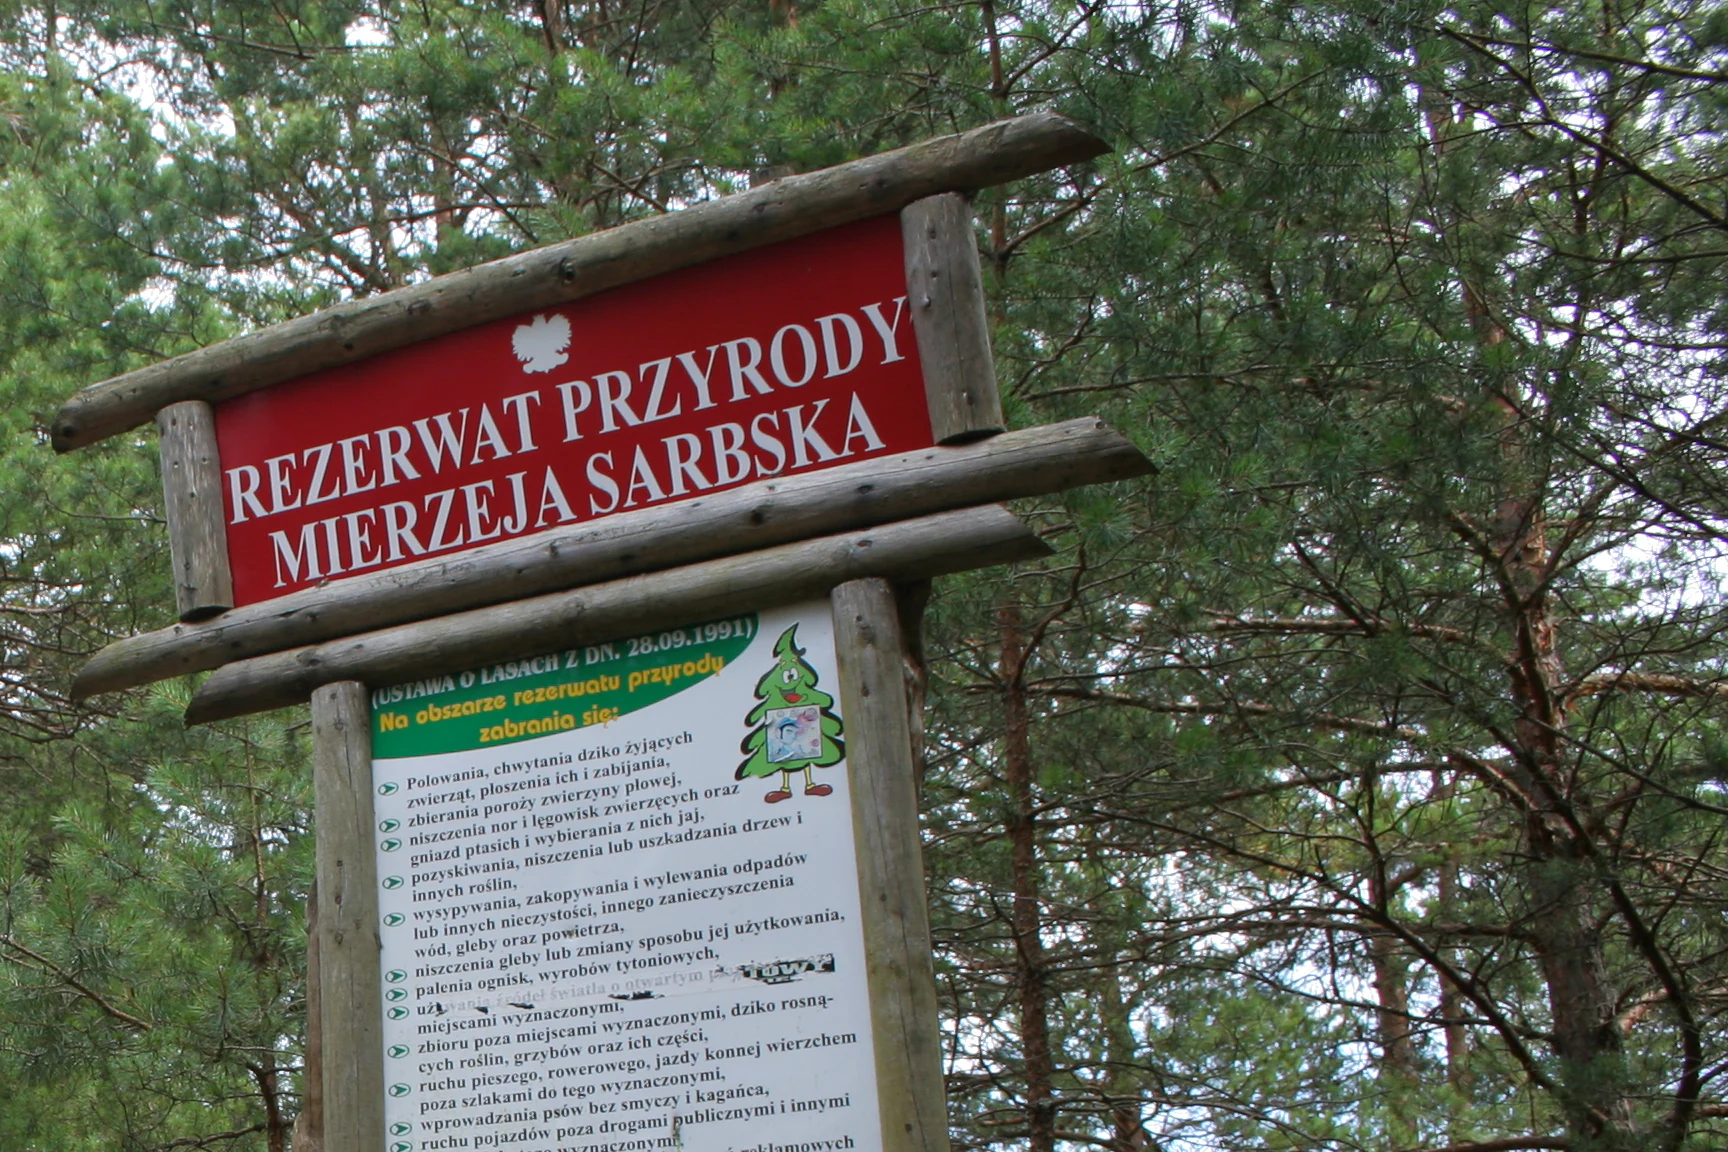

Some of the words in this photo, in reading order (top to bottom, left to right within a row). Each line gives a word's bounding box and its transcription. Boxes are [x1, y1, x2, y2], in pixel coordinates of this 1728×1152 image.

[225, 390, 542, 525] REZERWAT
[555, 295, 907, 442] PRZYRODY
[268, 465, 577, 589] MIERZEJA
[586, 391, 886, 515] SARBSKA
[372, 675, 455, 709] (USTAWA
[460, 671, 475, 688] O
[480, 655, 559, 685] LASACH
[565, 650, 579, 669] Z
[585, 642, 620, 665] DN.
[627, 618, 753, 658] 28.09.1991)
[380, 712, 409, 732] Na
[415, 694, 506, 725] obszarze
[513, 674, 620, 707] rezerwatu
[628, 652, 725, 692] przyrody
[479, 710, 575, 742] zabrania
[583, 703, 619, 728] się:
[406, 765, 490, 791] Polowania,
[492, 751, 573, 776] chwytania
[576, 744, 621, 762] dziko
[624, 729, 693, 755] żyjących
[406, 787, 476, 810] zwierząt,
[554, 768, 579, 785] ich
[583, 766, 589, 781] i
[592, 755, 671, 779] zabijania,
[407, 804, 480, 828] zbierania
[483, 795, 536, 820] poroży
[540, 785, 619, 807] zwierzyny
[408, 822, 487, 847] niszczenia
[490, 819, 518, 834] nor
[521, 814, 528, 829] i
[531, 804, 600, 830] lęgowisk
[603, 787, 699, 817] zwierzęcych
[703, 783, 740, 800] oraz
[409, 844, 461, 869] gniazd
[464, 835, 521, 861] ptasich
[524, 833, 530, 848] i
[533, 820, 622, 846] wybierania
[626, 820, 636, 832] z
[638, 811, 673, 830] nich
[677, 806, 705, 827] jaj,
[410, 856, 520, 888] pozyskiwania,
[523, 843, 604, 868] niszczenia
[607, 837, 634, 855] lub
[637, 821, 738, 850] uszkadzania
[741, 815, 791, 833] drzew
[796, 809, 803, 825] i
[411, 882, 464, 903] innych
[468, 876, 518, 895] roślin,
[412, 894, 522, 921] wysypywania,
[525, 878, 629, 906] zakopywania
[633, 875, 639, 890] i
[642, 863, 729, 888] wylewania
[731, 851, 808, 876] odpadów
[413, 924, 439, 941] lub
[442, 916, 496, 937] innych
[500, 902, 598, 929] nieczystości,
[600, 896, 655, 915] innego
[658, 873, 795, 906] zanieczyszczenia
[413, 941, 452, 959] wód,
[455, 937, 496, 958] gleby
[501, 933, 538, 948] oraz
[540, 921, 625, 947] powietrza,
[414, 956, 495, 978] niszczenia
[498, 950, 541, 972] gleby
[544, 945, 572, 962] lub
[575, 939, 634, 958] zmiany
[637, 927, 704, 952] sposobu
[708, 921, 730, 943] jej
[733, 907, 846, 936] użytkowania,
[415, 978, 473, 1001] palenia
[476, 970, 534, 992] ognisk,
[537, 960, 610, 982] wyrobów
[615, 944, 720, 972] tytoniowych,
[416, 1012, 497, 1036] miejscami
[417, 1038, 469, 1055] zbioru
[473, 1034, 512, 1052] poza
[515, 1020, 597, 1044] miejscami
[601, 1004, 727, 1033] wyznaczonymi,
[729, 999, 776, 1018] dziko
[780, 994, 834, 1011] rosną-
[417, 1056, 454, 1074] cych
[458, 1051, 510, 1070] roślin,
[512, 1043, 582, 1067] grzybów
[586, 1040, 624, 1056] oraz
[627, 1034, 652, 1051] ich
[656, 1026, 709, 1049] części,
[418, 1075, 467, 1093] ruchu
[471, 1070, 543, 1092] pieszego,
[547, 1058, 651, 1080] rowerowego,
[655, 1049, 700, 1071] jazdy
[704, 1040, 762, 1062] konnej
[765, 1031, 857, 1053] wierzchem
[419, 1098, 457, 1116] poza
[461, 1087, 533, 1108] szlakami
[536, 1085, 558, 1101] do
[561, 1083, 596, 1100] tego
[599, 1065, 726, 1093] wyznaczonymi,
[419, 1107, 538, 1134] wprowadzania
[542, 1102, 584, 1124] psów
[588, 1100, 617, 1115] bez
[620, 1094, 680, 1112] smyczy
[684, 1089, 691, 1105] i
[695, 1082, 770, 1105] kagańca,
[420, 1134, 469, 1151] ruchu
[473, 1125, 550, 1150] pojazdów
[555, 1124, 594, 1142] poza
[598, 1112, 668, 1135] drogami
[672, 1101, 775, 1129] publicznymi
[779, 1098, 786, 1114] i
[790, 1091, 851, 1113] innymi
